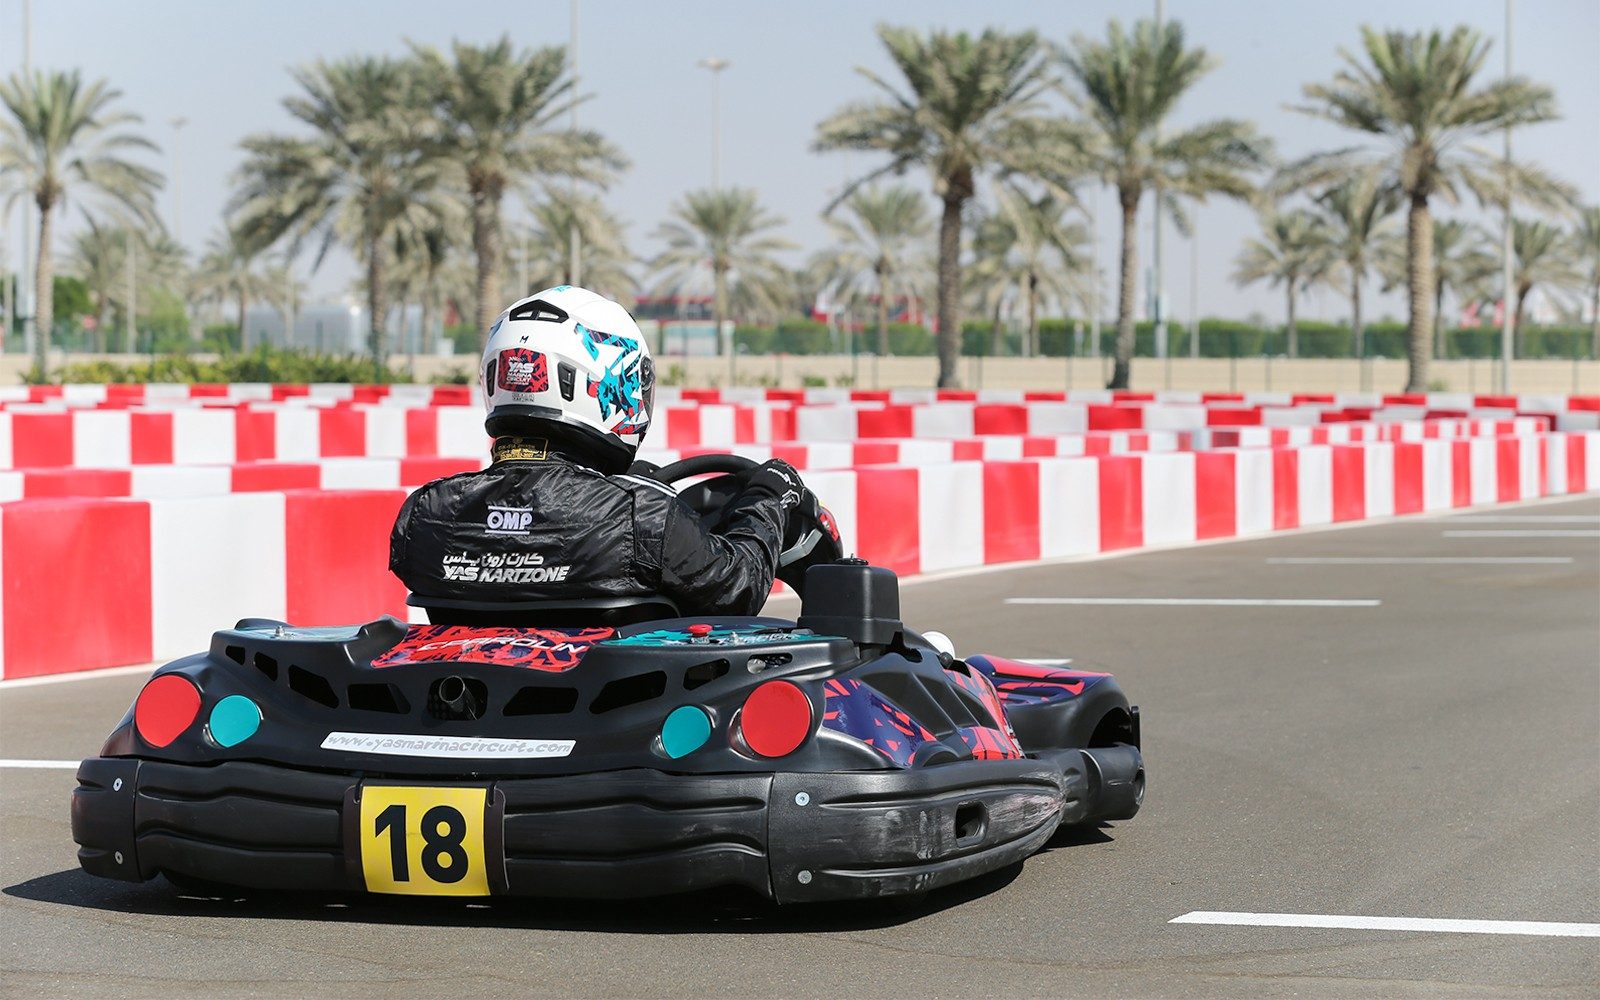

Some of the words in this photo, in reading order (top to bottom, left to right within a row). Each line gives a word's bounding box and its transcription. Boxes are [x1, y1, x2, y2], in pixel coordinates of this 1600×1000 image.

[508, 362, 534, 373] YAS
[487, 511, 532, 530] OMP
[506, 553, 544, 567] كارت
[443, 565, 480, 581] YAS
[479, 565, 571, 583] KARTZONE
[328, 736, 572, 753] www.yasmarinacircuit.com
[374, 804, 469, 884] 18
